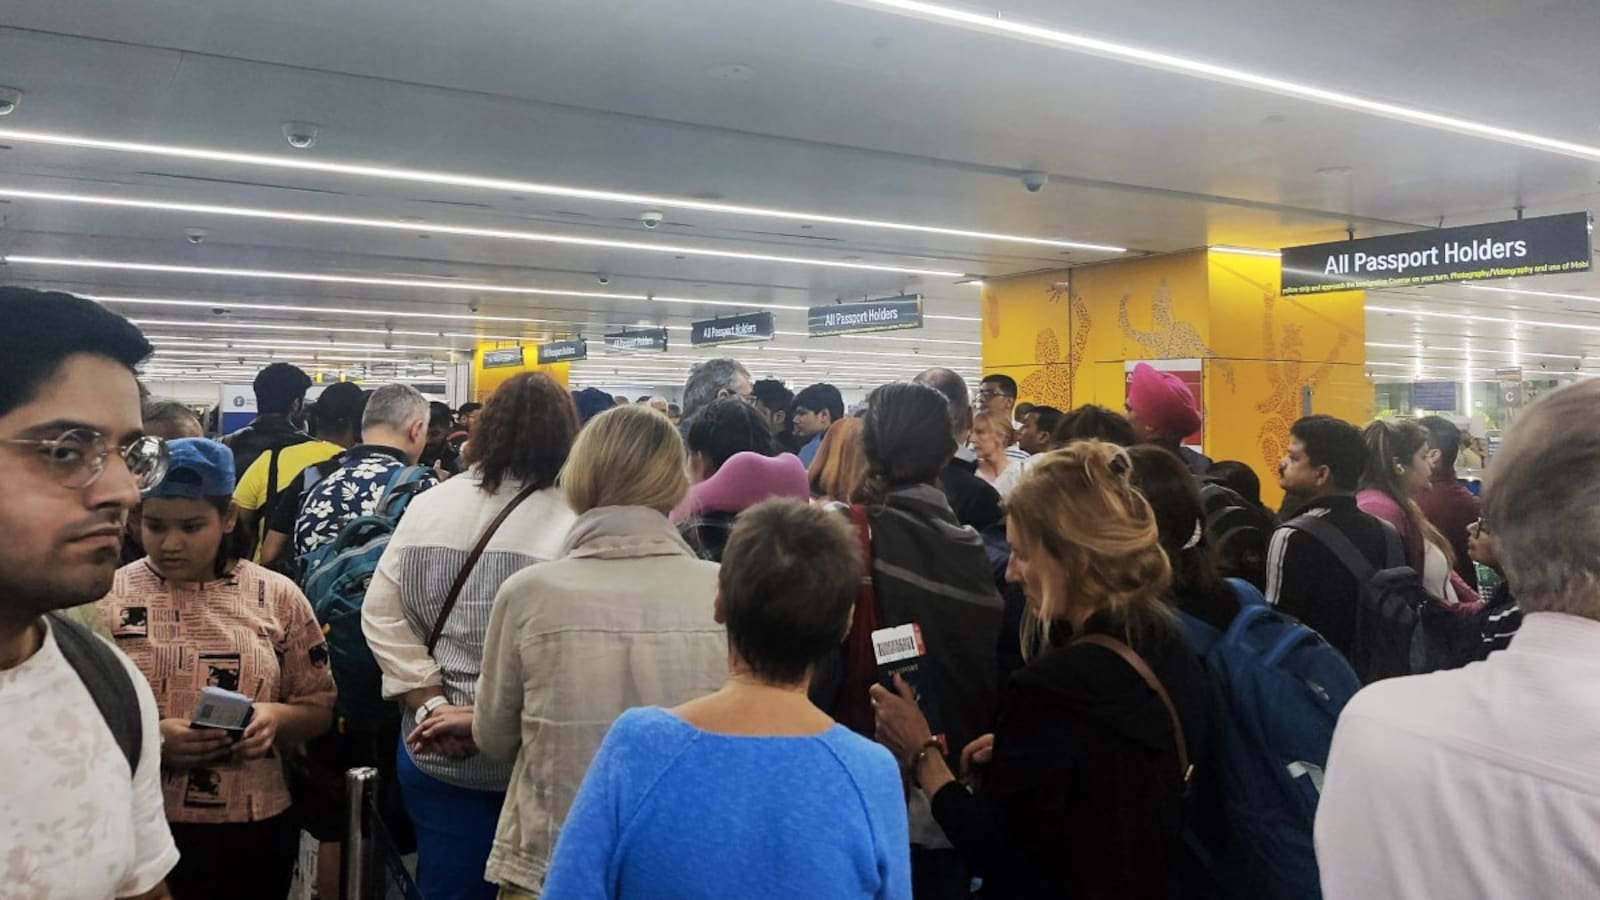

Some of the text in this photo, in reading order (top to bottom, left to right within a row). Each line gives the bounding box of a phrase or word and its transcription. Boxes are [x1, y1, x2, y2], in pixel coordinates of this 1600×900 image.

[1324, 238, 1527, 275] All Passport Holders
[1534, 264, 1547, 272] and
[824, 307, 898, 326] All Passport Holders
[1505, 391, 1514, 402] C
